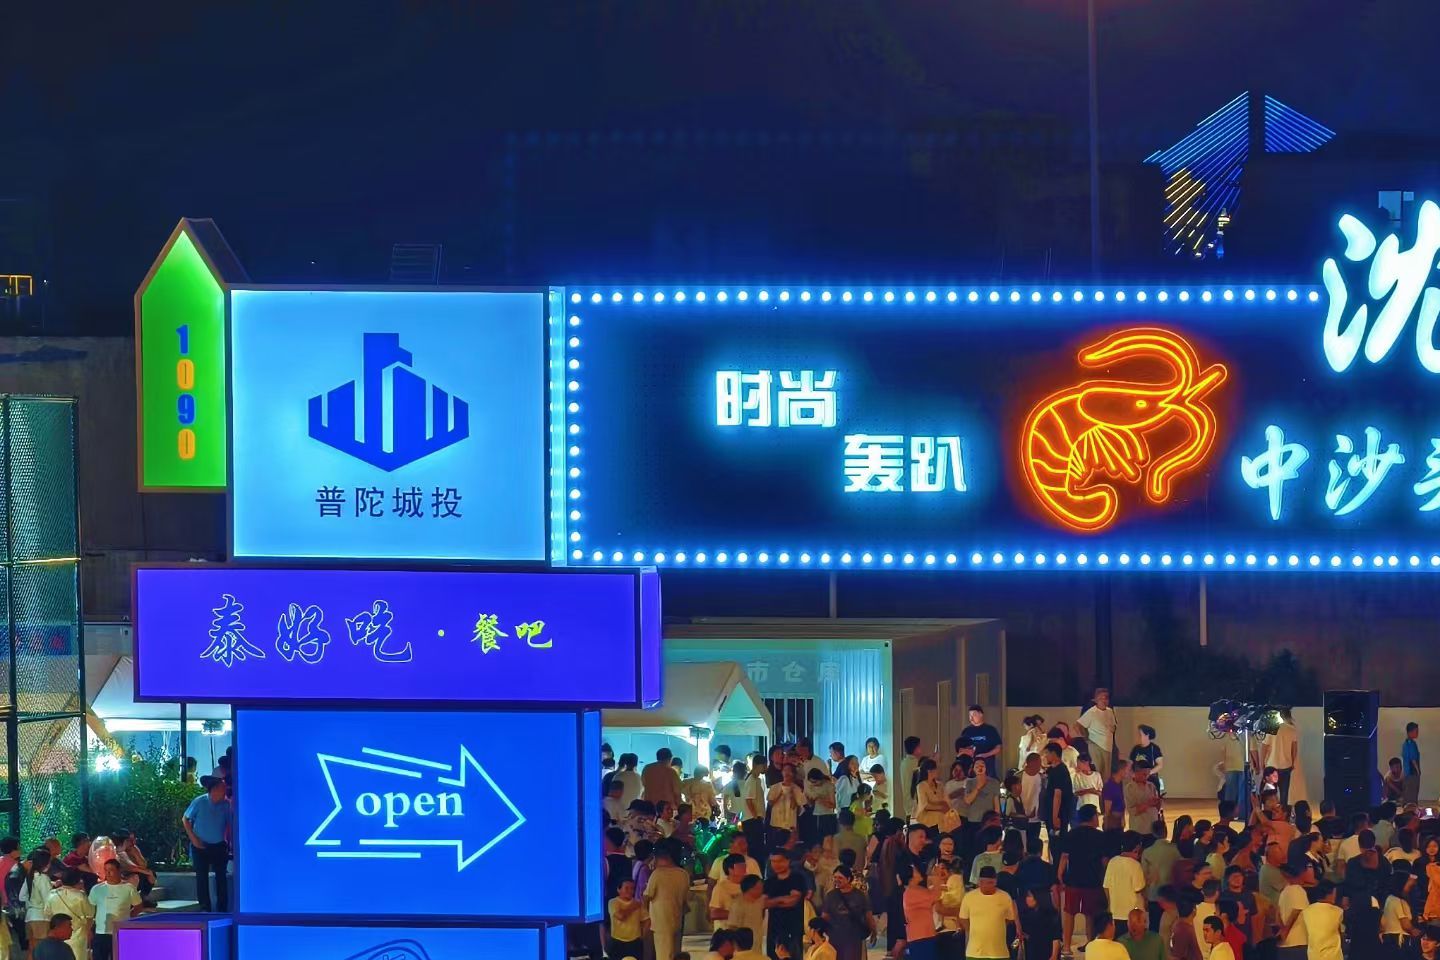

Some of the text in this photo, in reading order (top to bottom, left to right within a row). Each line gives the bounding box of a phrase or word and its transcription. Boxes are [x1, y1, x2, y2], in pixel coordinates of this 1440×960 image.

[175, 323, 197, 461] 1090
[715, 369, 837, 428] 时尚
[843, 433, 967, 493] 轰趴
[315, 486, 464, 519] 普陀城投
[355, 785, 465, 828] open
